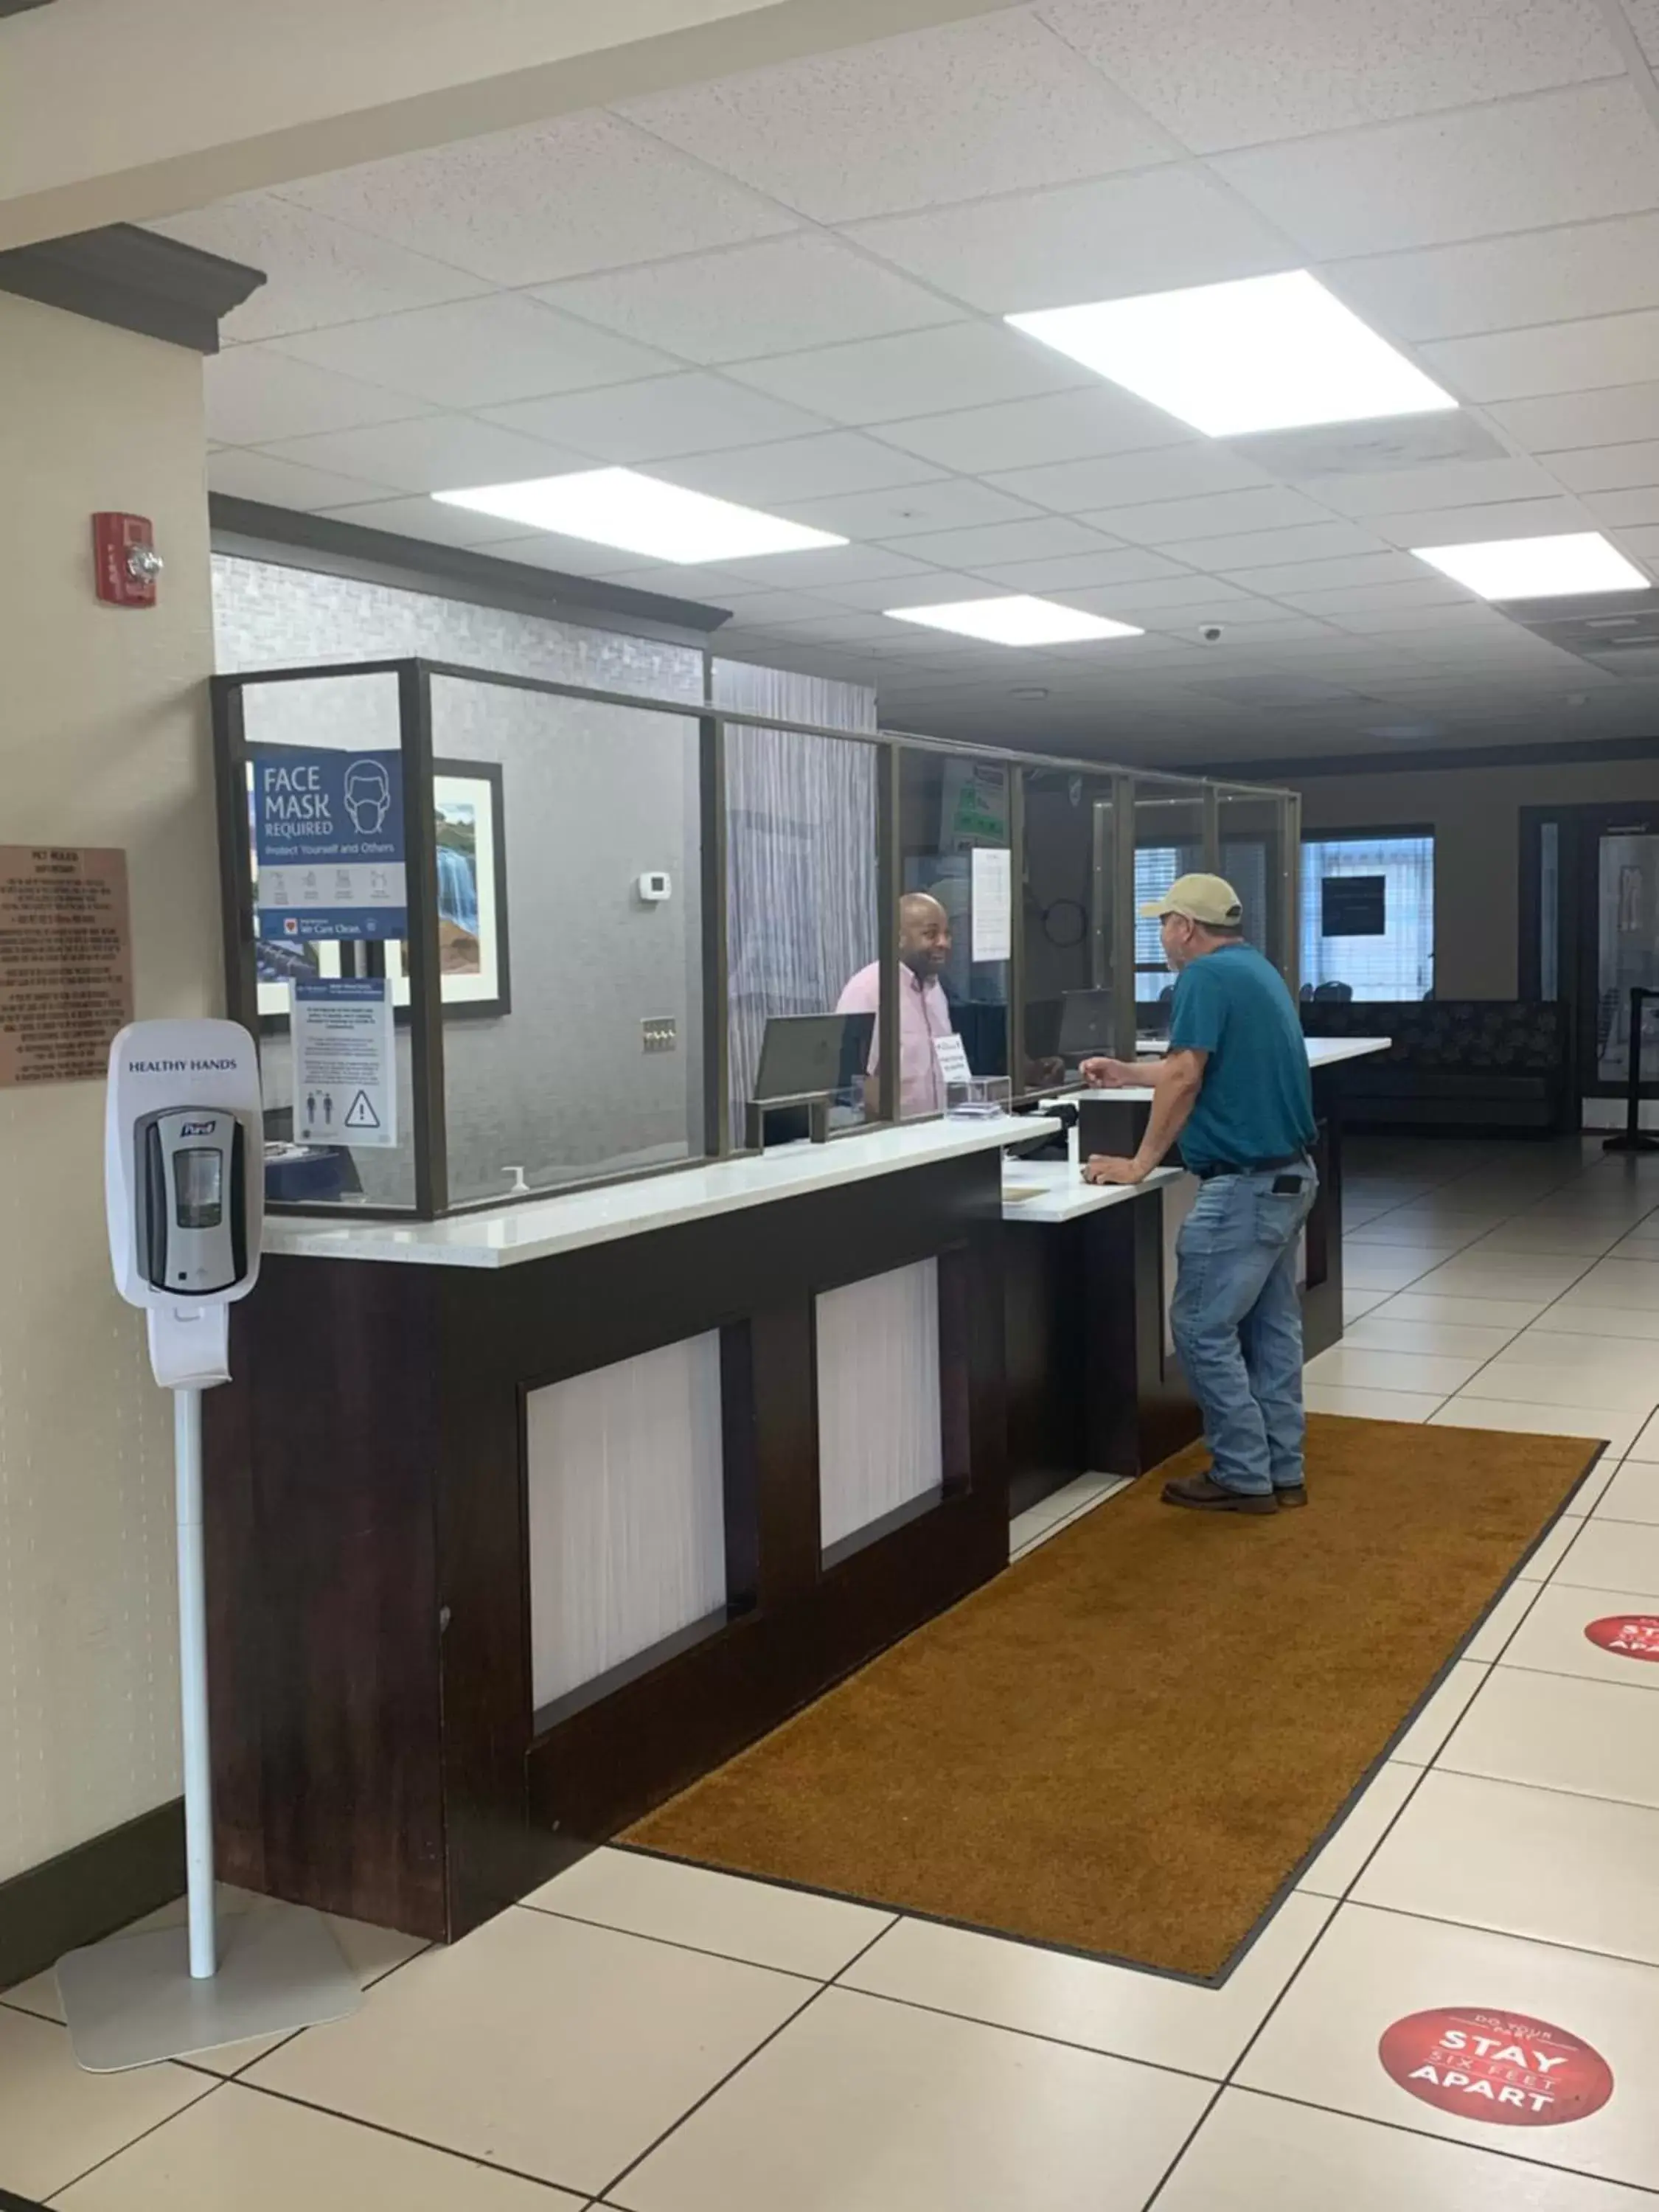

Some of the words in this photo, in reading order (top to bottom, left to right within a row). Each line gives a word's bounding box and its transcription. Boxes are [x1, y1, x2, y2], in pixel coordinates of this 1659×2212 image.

[265, 766, 321, 792] FACE
[265, 793, 331, 821] MASK
[265, 821, 333, 839] REQUIRED
[265, 845, 298, 855] Protect
[301, 844, 338, 855] Yourself
[340, 844, 358, 853] and
[361, 842, 395, 853] Others
[129, 1060, 186, 1073] HEALTHY
[190, 1059, 237, 1071] HANDS
[1475, 2014, 1501, 2027] DO
[1508, 2023, 1553, 2040] YOUR
[1439, 2029, 1569, 2073] STAY
[1427, 2050, 1474, 2070] SIX
[1487, 2065, 1556, 2091] FEET
[1408, 2065, 1556, 2112] APART
